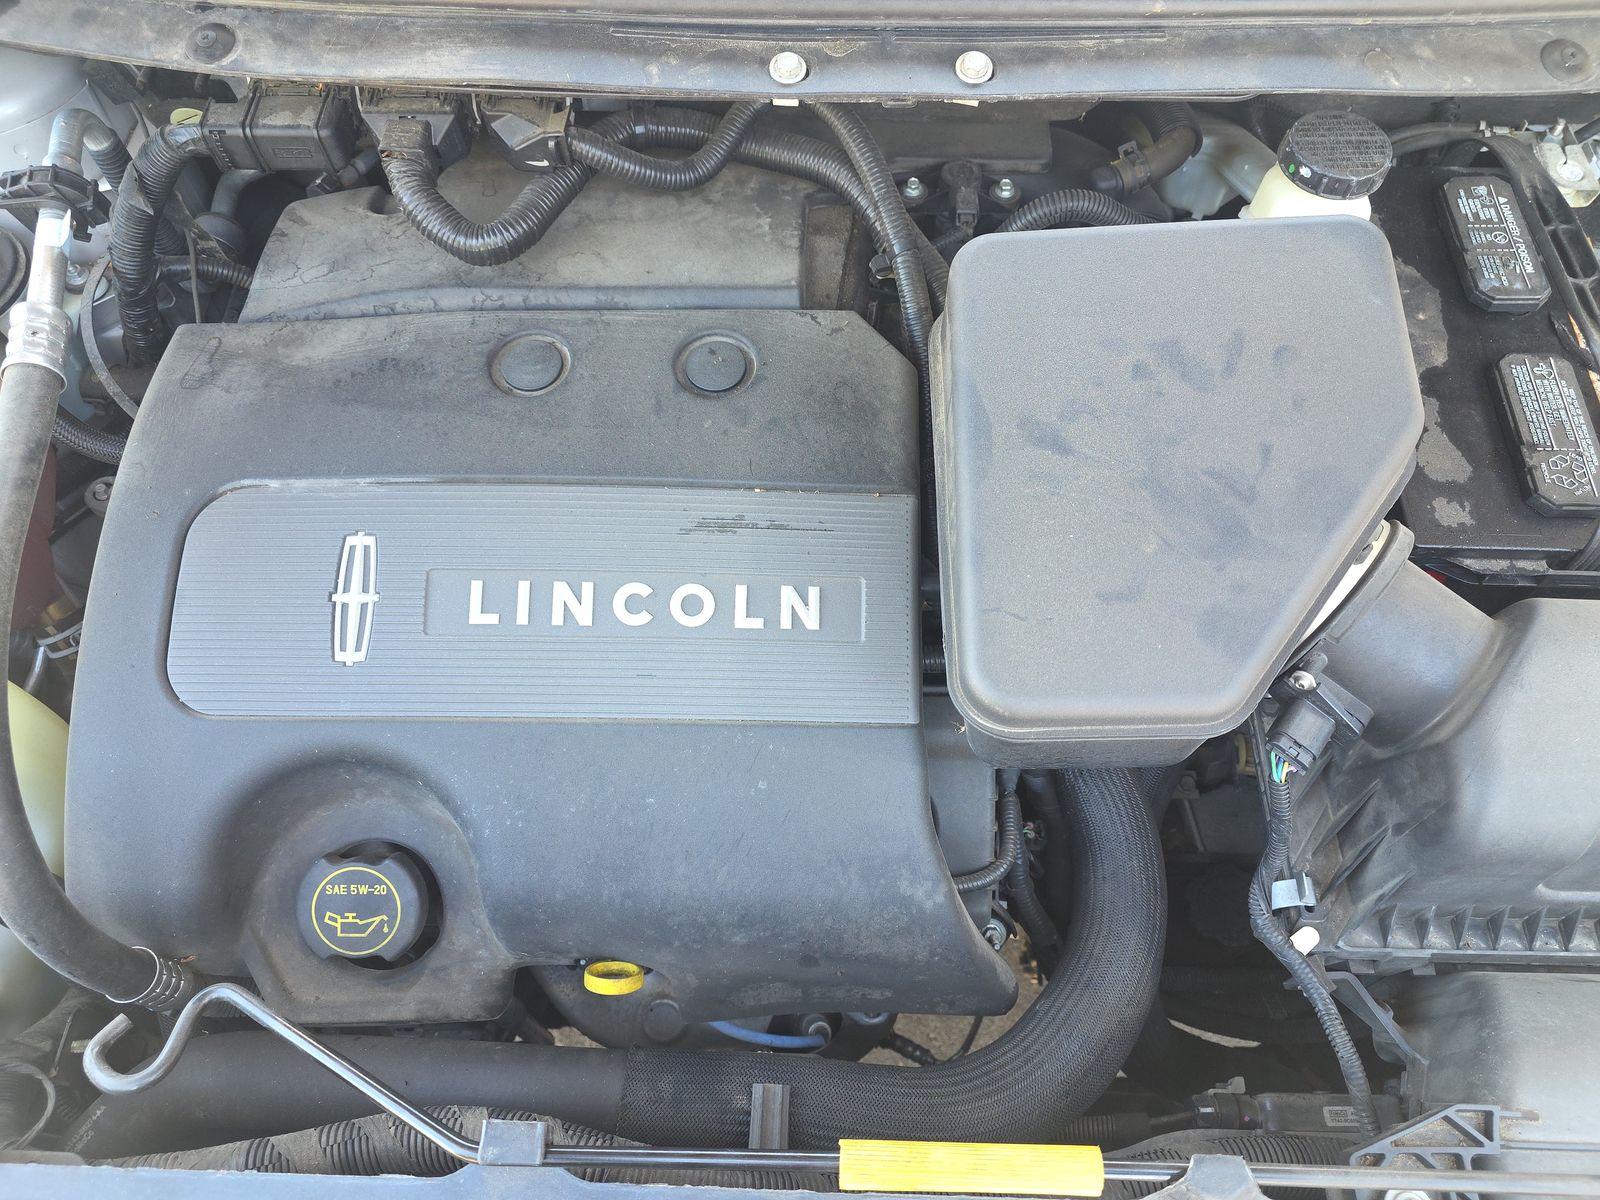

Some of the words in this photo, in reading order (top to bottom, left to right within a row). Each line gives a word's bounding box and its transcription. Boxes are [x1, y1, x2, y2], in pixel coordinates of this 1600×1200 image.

[1501, 204, 1520, 236] DANGER
[1516, 243, 1535, 273] POISON
[1542, 400, 1552, 413] HELP
[1550, 379, 1560, 395] FLUSH
[1555, 395, 1564, 408] EYES
[468, 580, 821, 631] LINCOLN
[325, 884, 347, 895] SAE
[350, 884, 387, 895] 5W-20
